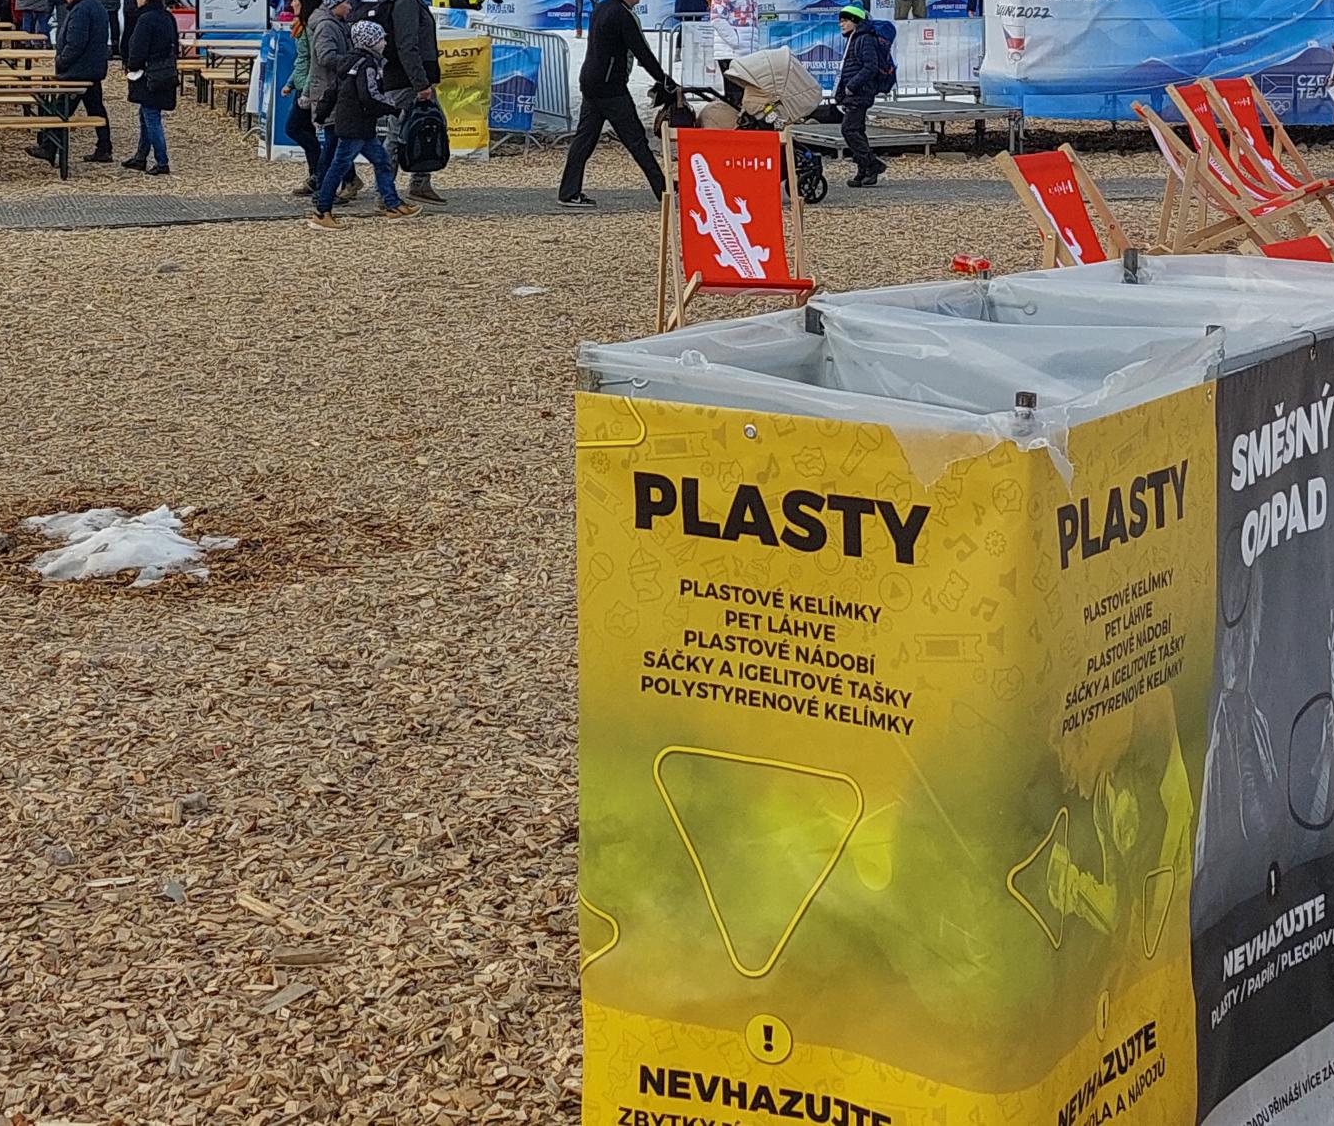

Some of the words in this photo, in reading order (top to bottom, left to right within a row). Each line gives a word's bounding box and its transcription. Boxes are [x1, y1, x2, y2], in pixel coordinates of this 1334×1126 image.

[1016, 5, 1054, 19] 2022
[437, 47, 483, 59] PLASTY
[1230, 382, 1334, 491] SMĚSNÝ
[633, 471, 932, 565] PLASTY
[1057, 458, 1188, 570] PLASTY
[1241, 477, 1328, 567] ODPAD
[679, 578, 785, 609] PLASTOVÉ
[790, 594, 882, 624] KELÍMKY
[725, 609, 762, 631] PET
[768, 614, 836, 643] LÁHVE
[1083, 582, 1131, 624] PLASTOVÉ
[1131, 568, 1175, 600] KELÍMKY
[1104, 617, 1122, 641] PET
[1123, 601, 1153, 631] LÁHVE
[683, 629, 789, 661] PLASTOVÉ
[795, 644, 876, 675] NÁDOBÍ
[1065, 675, 1101, 710] SÁČKY
[1101, 676, 1110, 693] A
[1111, 644, 1157, 689] IGELITOVÉ
[1157, 633, 1186, 663] TAŠKY
[1086, 634, 1135, 676] PLASTOVÉ
[1136, 613, 1172, 650] NÁDOBÍ
[641, 675, 819, 717] POLYSTYRENOVÉ
[824, 702, 914, 736] KELÍMKY
[643, 648, 714, 675] SÁČKY
[719, 660, 735, 678] A
[739, 663, 843, 696] IGELITOVÉ
[847, 678, 912, 710] TAŠKY
[1062, 677, 1145, 737] POLYSTYRENOVÉ
[1146, 656, 1184, 692] KELÍMKY
[1223, 893, 1326, 982] NEVHAZUJTE
[1211, 984, 1241, 1029] PLASTY
[1247, 962, 1275, 997] PAPÍR
[1116, 1093, 1126, 1116] A
[1128, 1053, 1167, 1109] NÁPOJŮ
[1268, 1084, 1302, 1118] PŘINÁŠÍ
[1301, 1068, 1322, 1093] VÍCE
